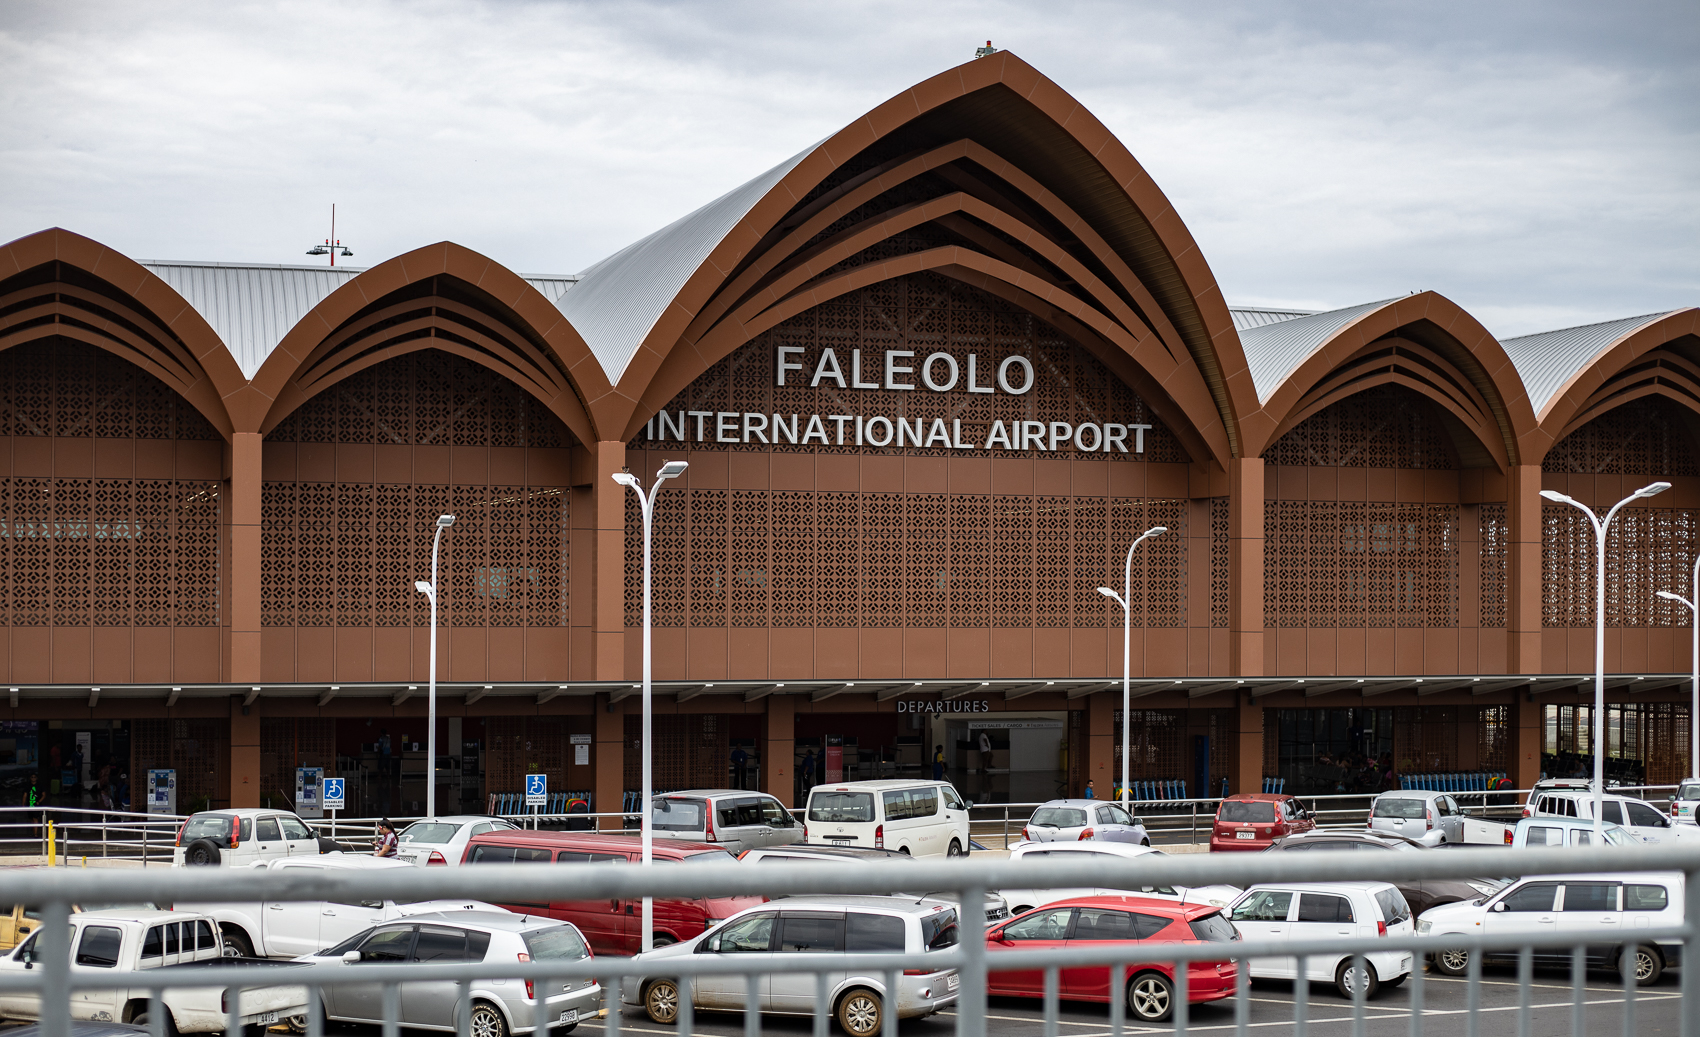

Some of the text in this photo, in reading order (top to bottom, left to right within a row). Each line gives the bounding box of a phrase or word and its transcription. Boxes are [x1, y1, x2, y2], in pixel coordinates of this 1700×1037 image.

[777, 345, 1034, 395] FALEOLO
[647, 409, 1152, 453] INTERNATIONAL AIRPORT
[897, 700, 989, 713] DEPARTURES
